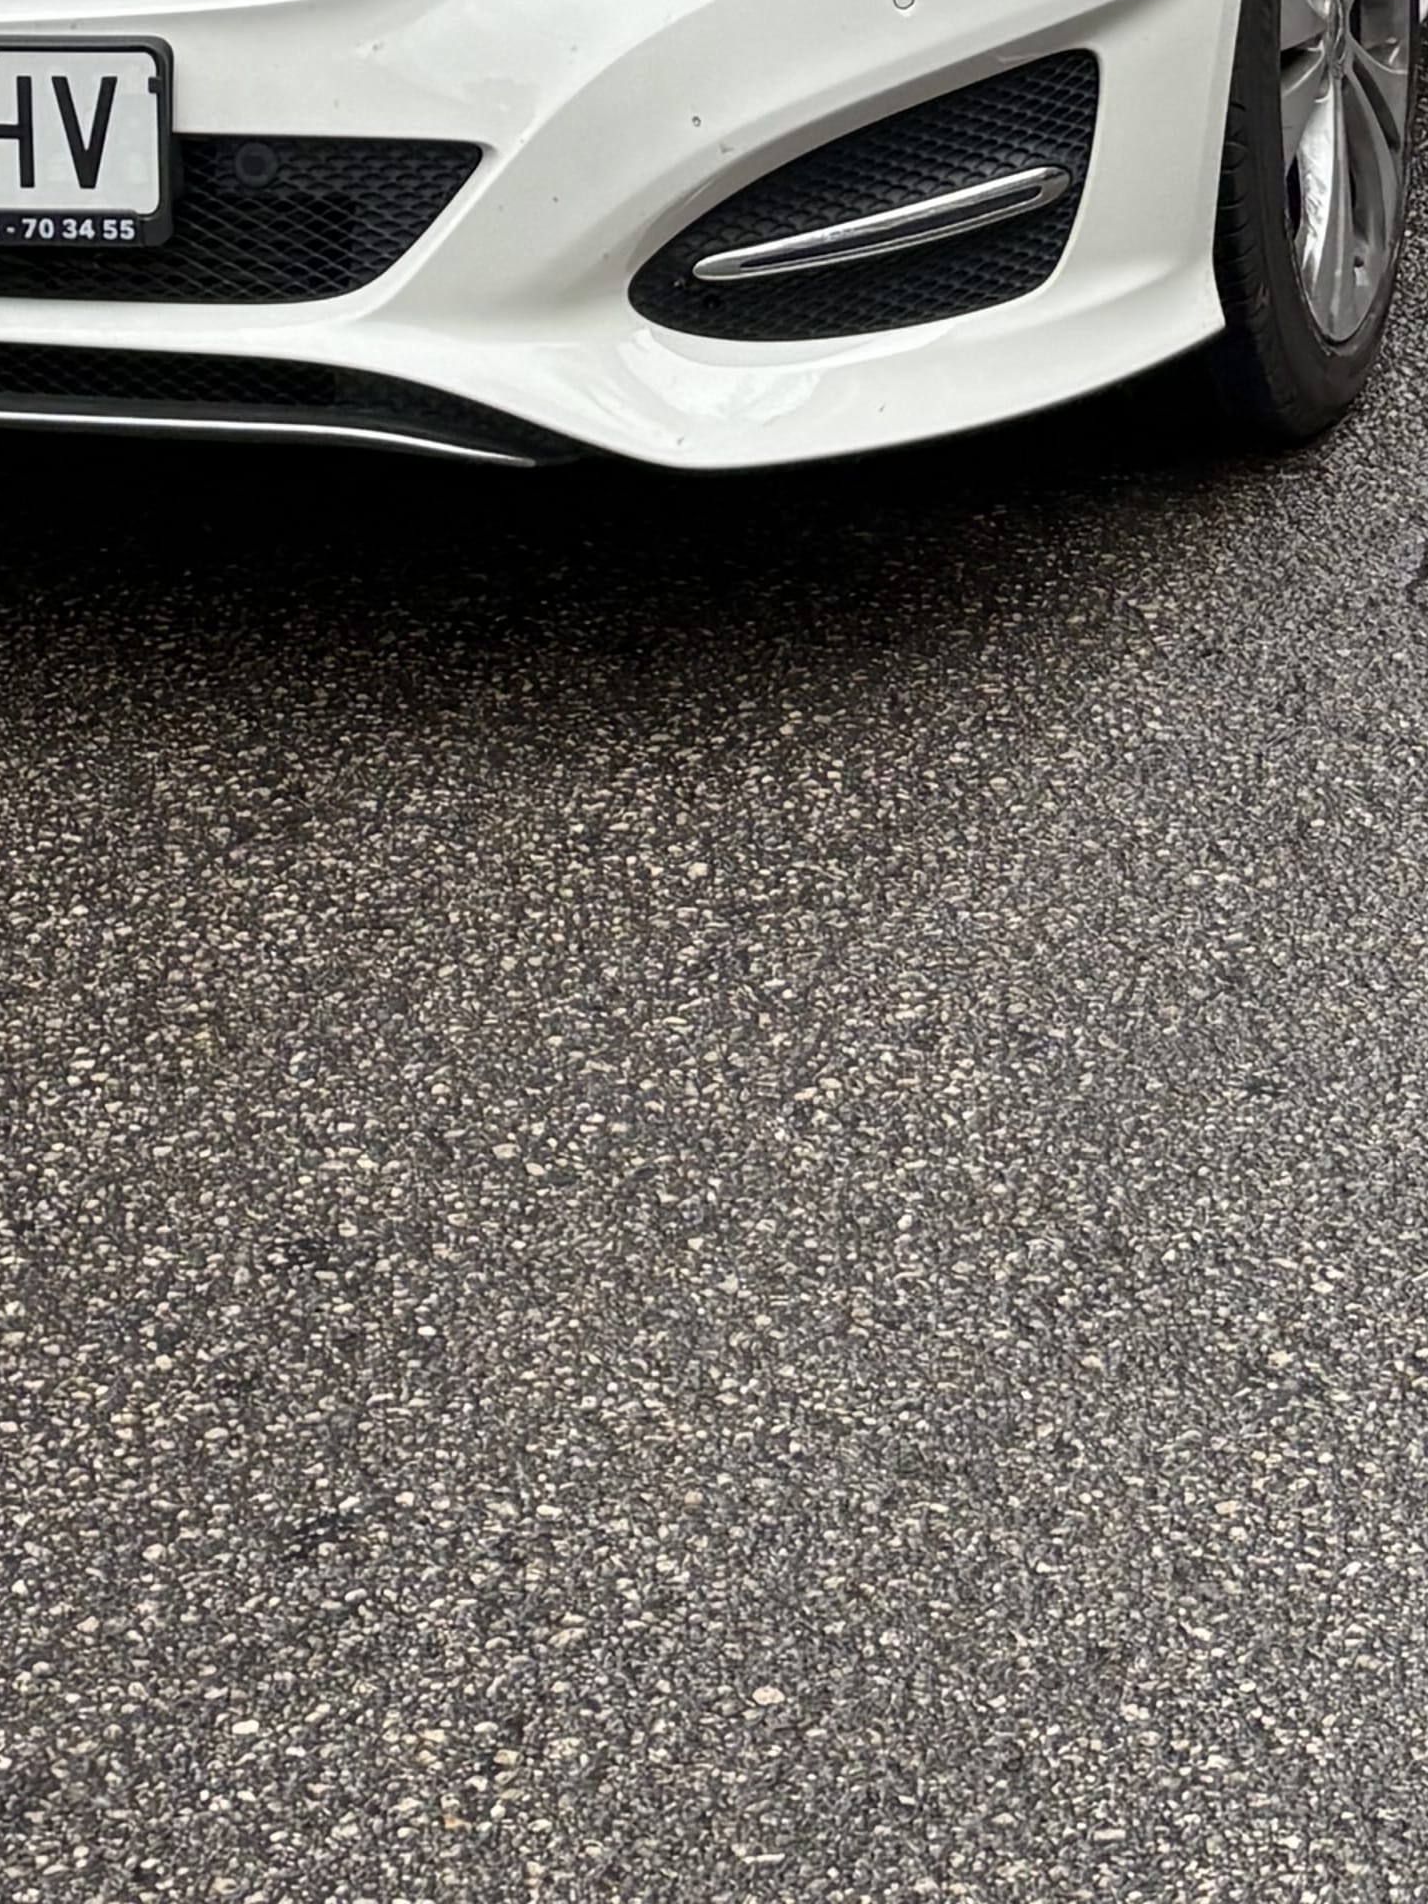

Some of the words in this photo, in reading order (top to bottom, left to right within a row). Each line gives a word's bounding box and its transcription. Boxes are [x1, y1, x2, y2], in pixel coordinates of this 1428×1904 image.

[22, 218, 55, 239] 70
[62, 219, 96, 239] 34
[103, 219, 136, 240] 55
